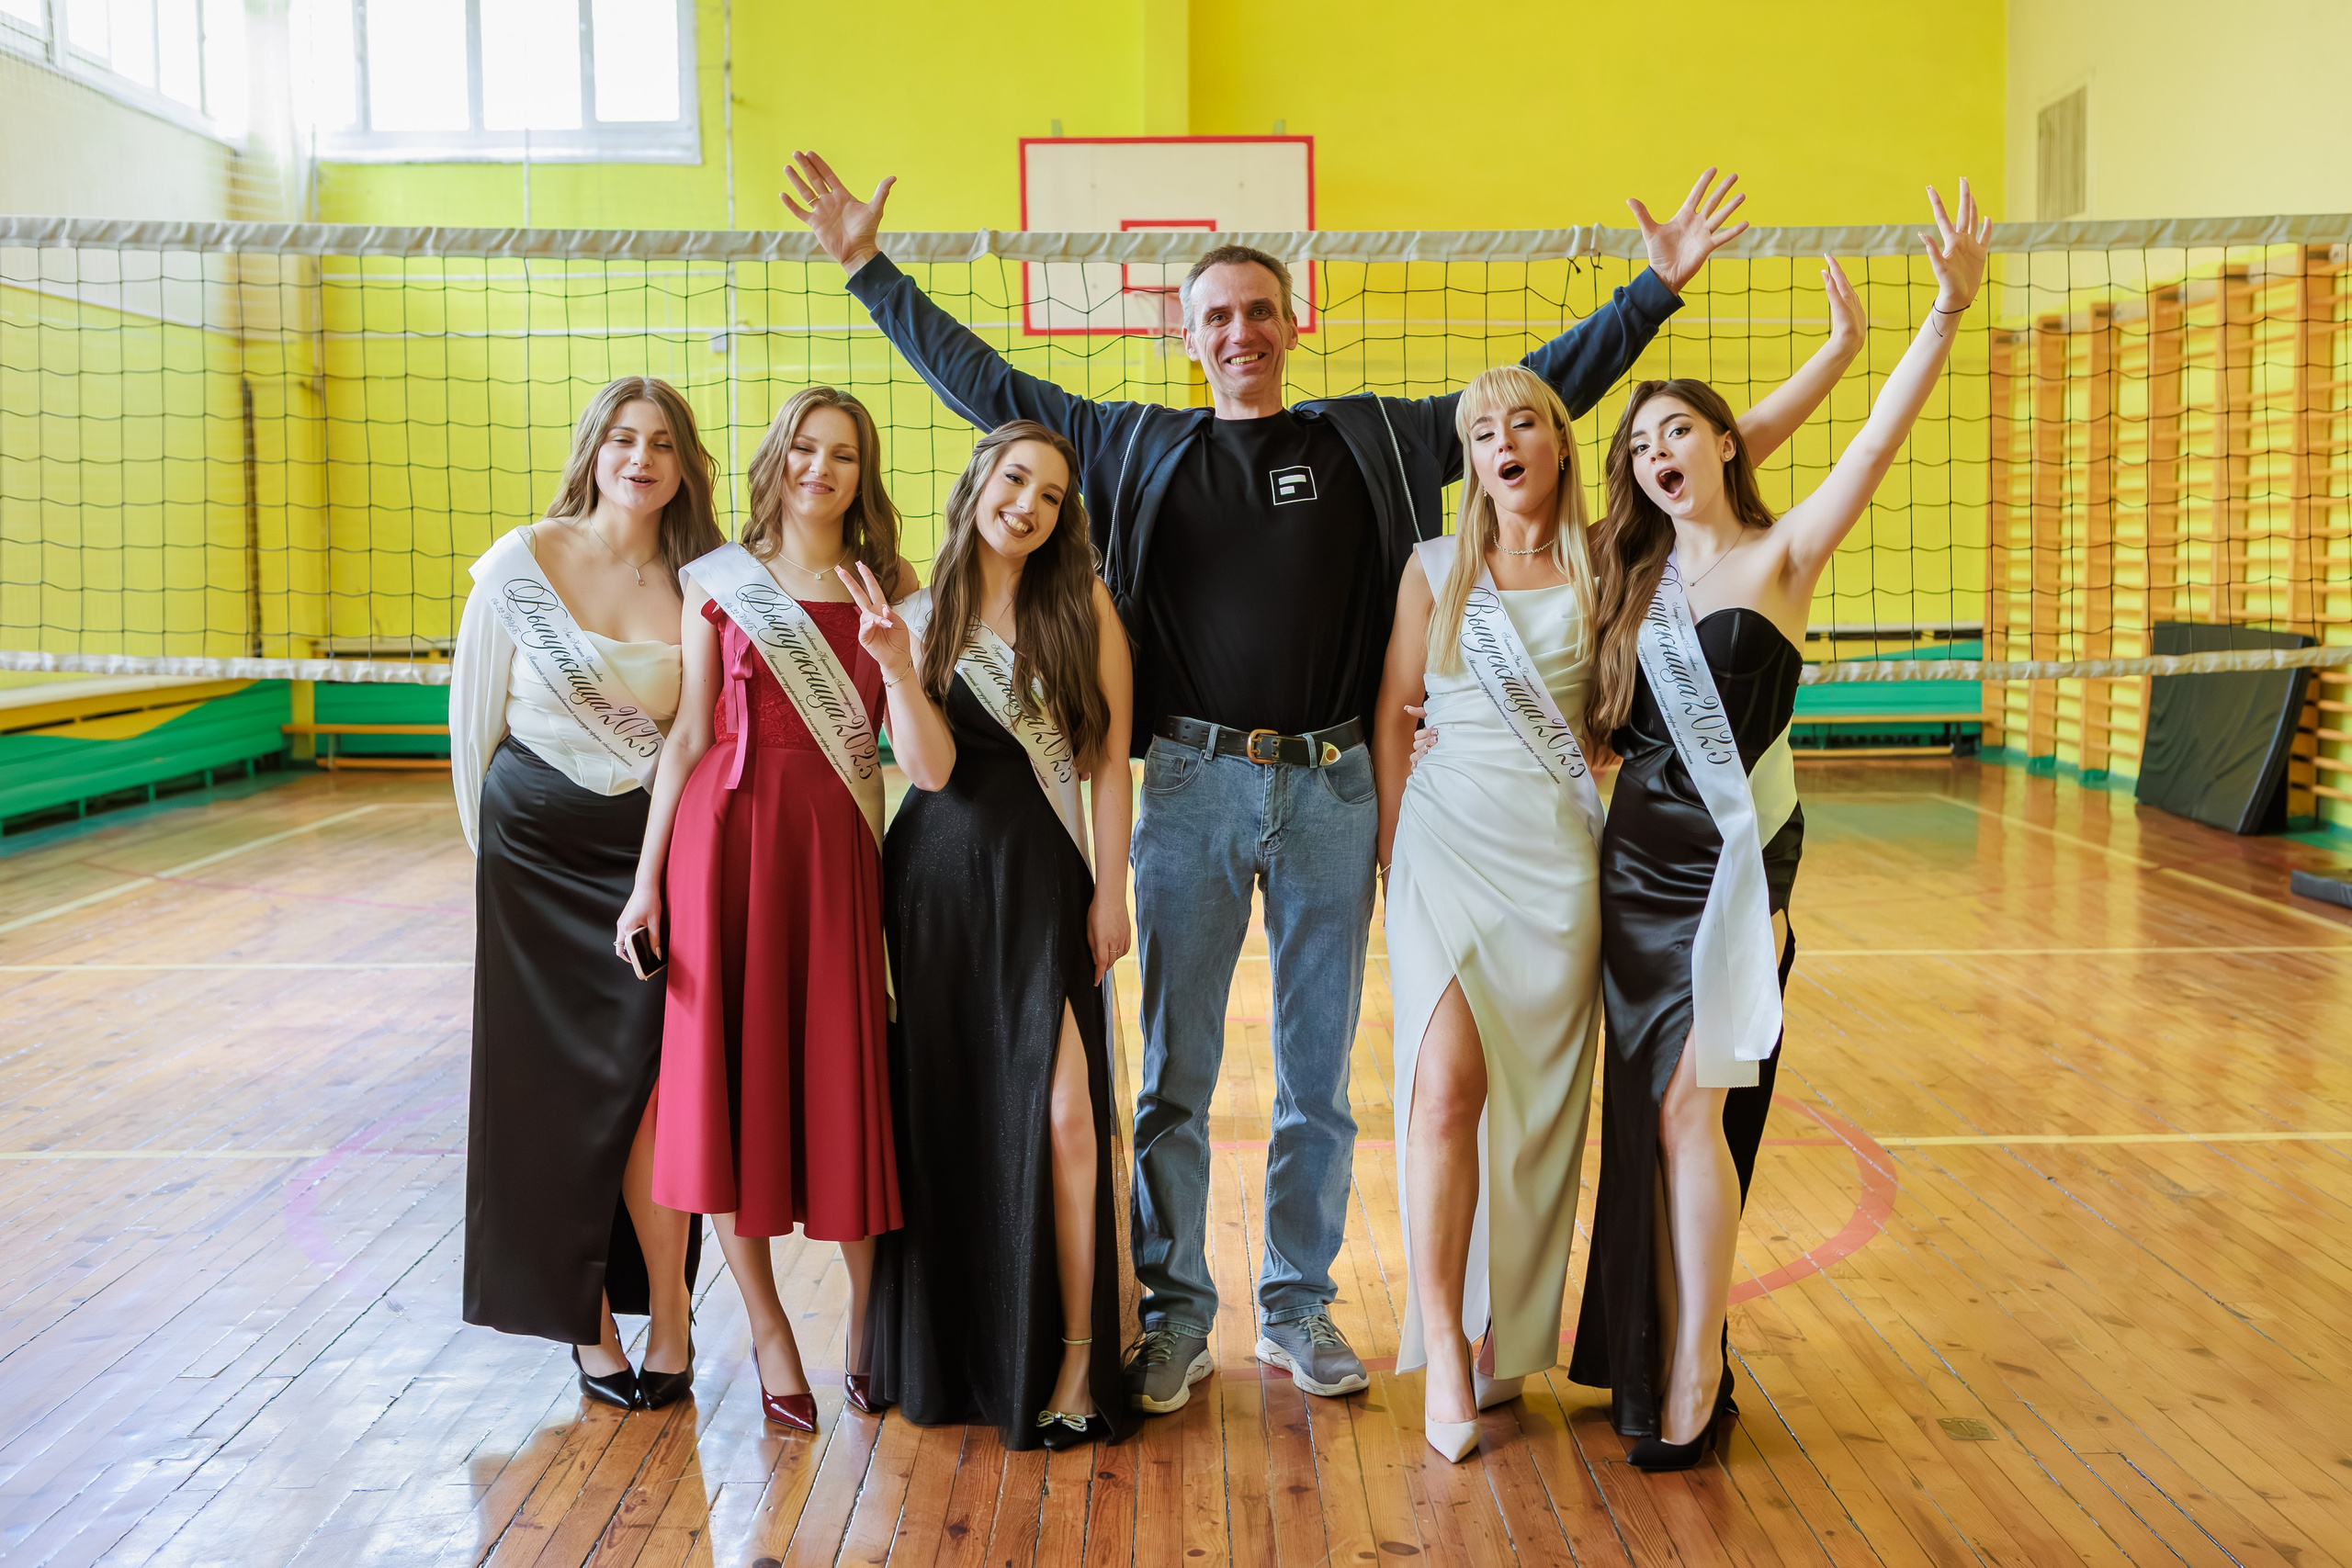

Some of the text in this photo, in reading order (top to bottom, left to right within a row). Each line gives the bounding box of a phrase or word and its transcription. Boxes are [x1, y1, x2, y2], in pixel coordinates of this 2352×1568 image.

[503, 578, 659, 758] Выпускница 2025
[736, 583, 882, 780] Выпускница 2025
[1680, 695, 1738, 765] 2025
